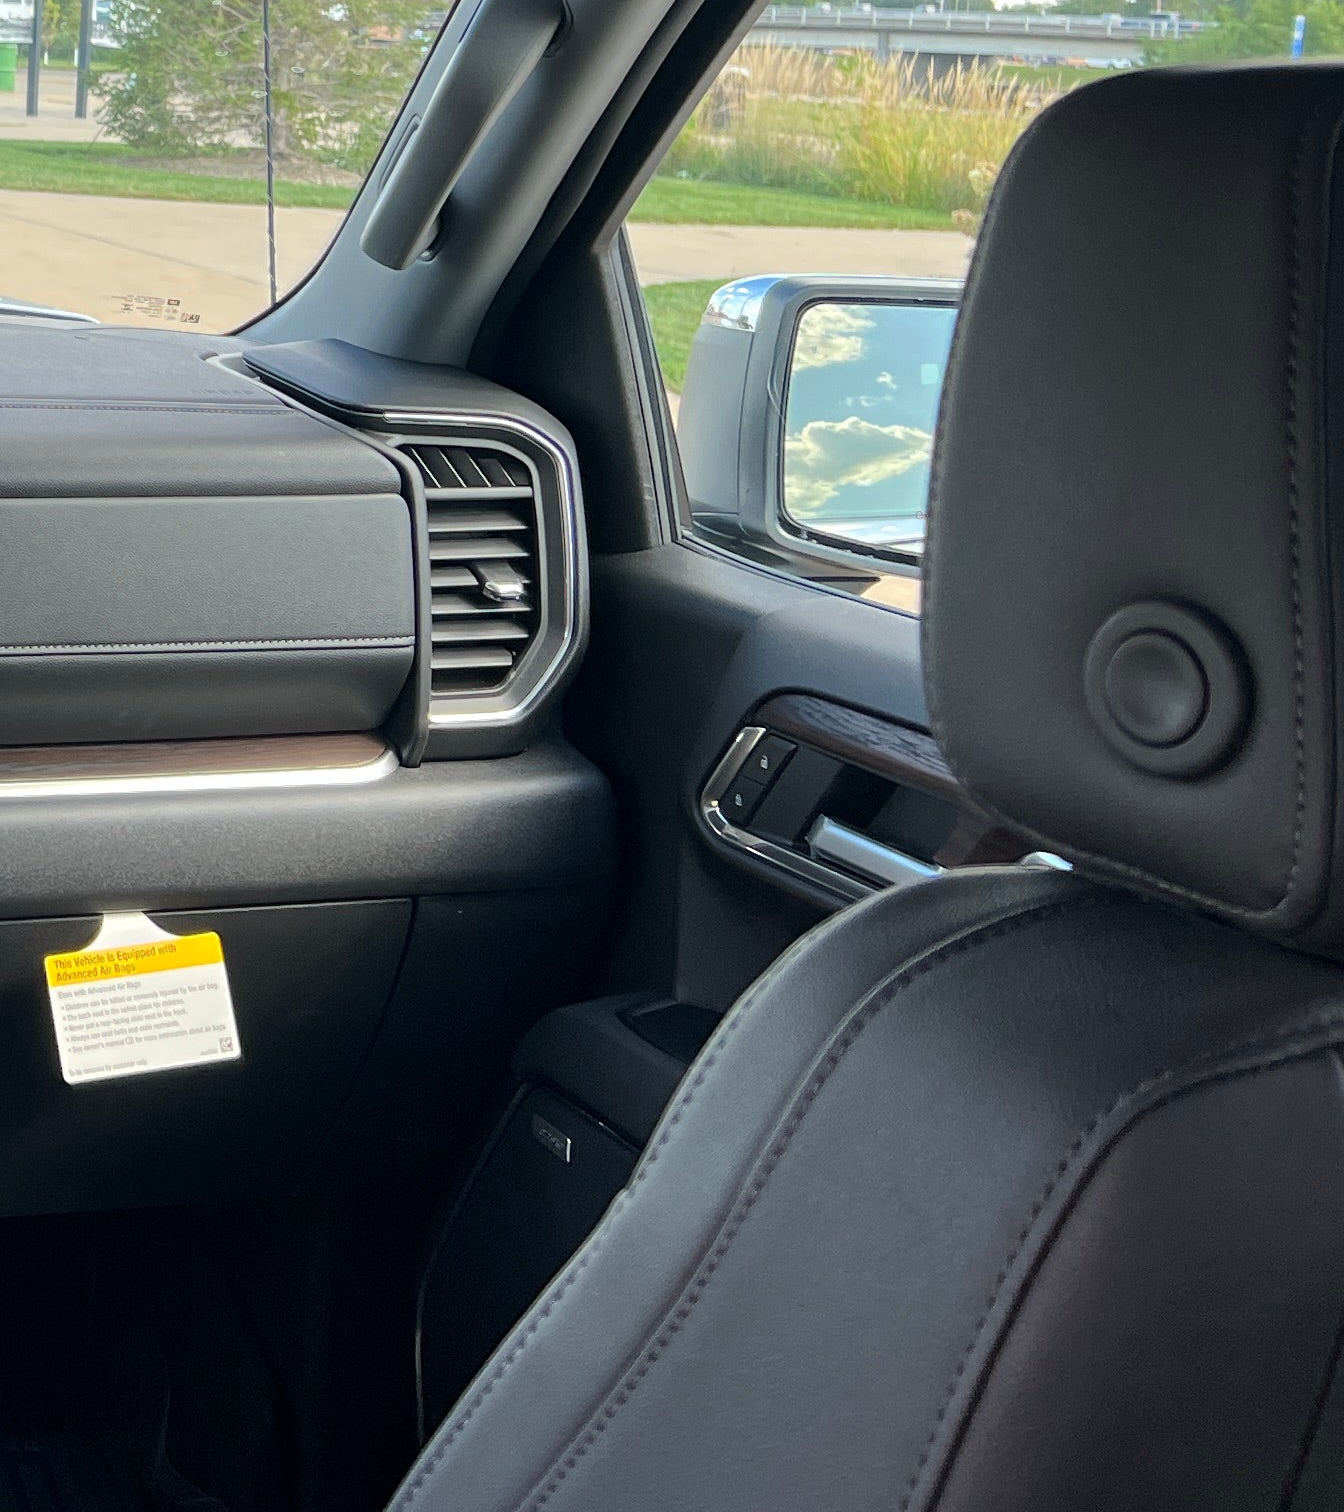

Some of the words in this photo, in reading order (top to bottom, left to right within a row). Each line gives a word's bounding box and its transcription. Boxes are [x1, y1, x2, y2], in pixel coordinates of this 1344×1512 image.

[54, 959, 73, 970] This
[74, 954, 106, 968] Vehicle
[117, 946, 156, 962] Equipped
[157, 943, 177, 954] with
[56, 969, 98, 982] Advanced
[100, 965, 113, 976] Air
[114, 962, 136, 975] Bags
